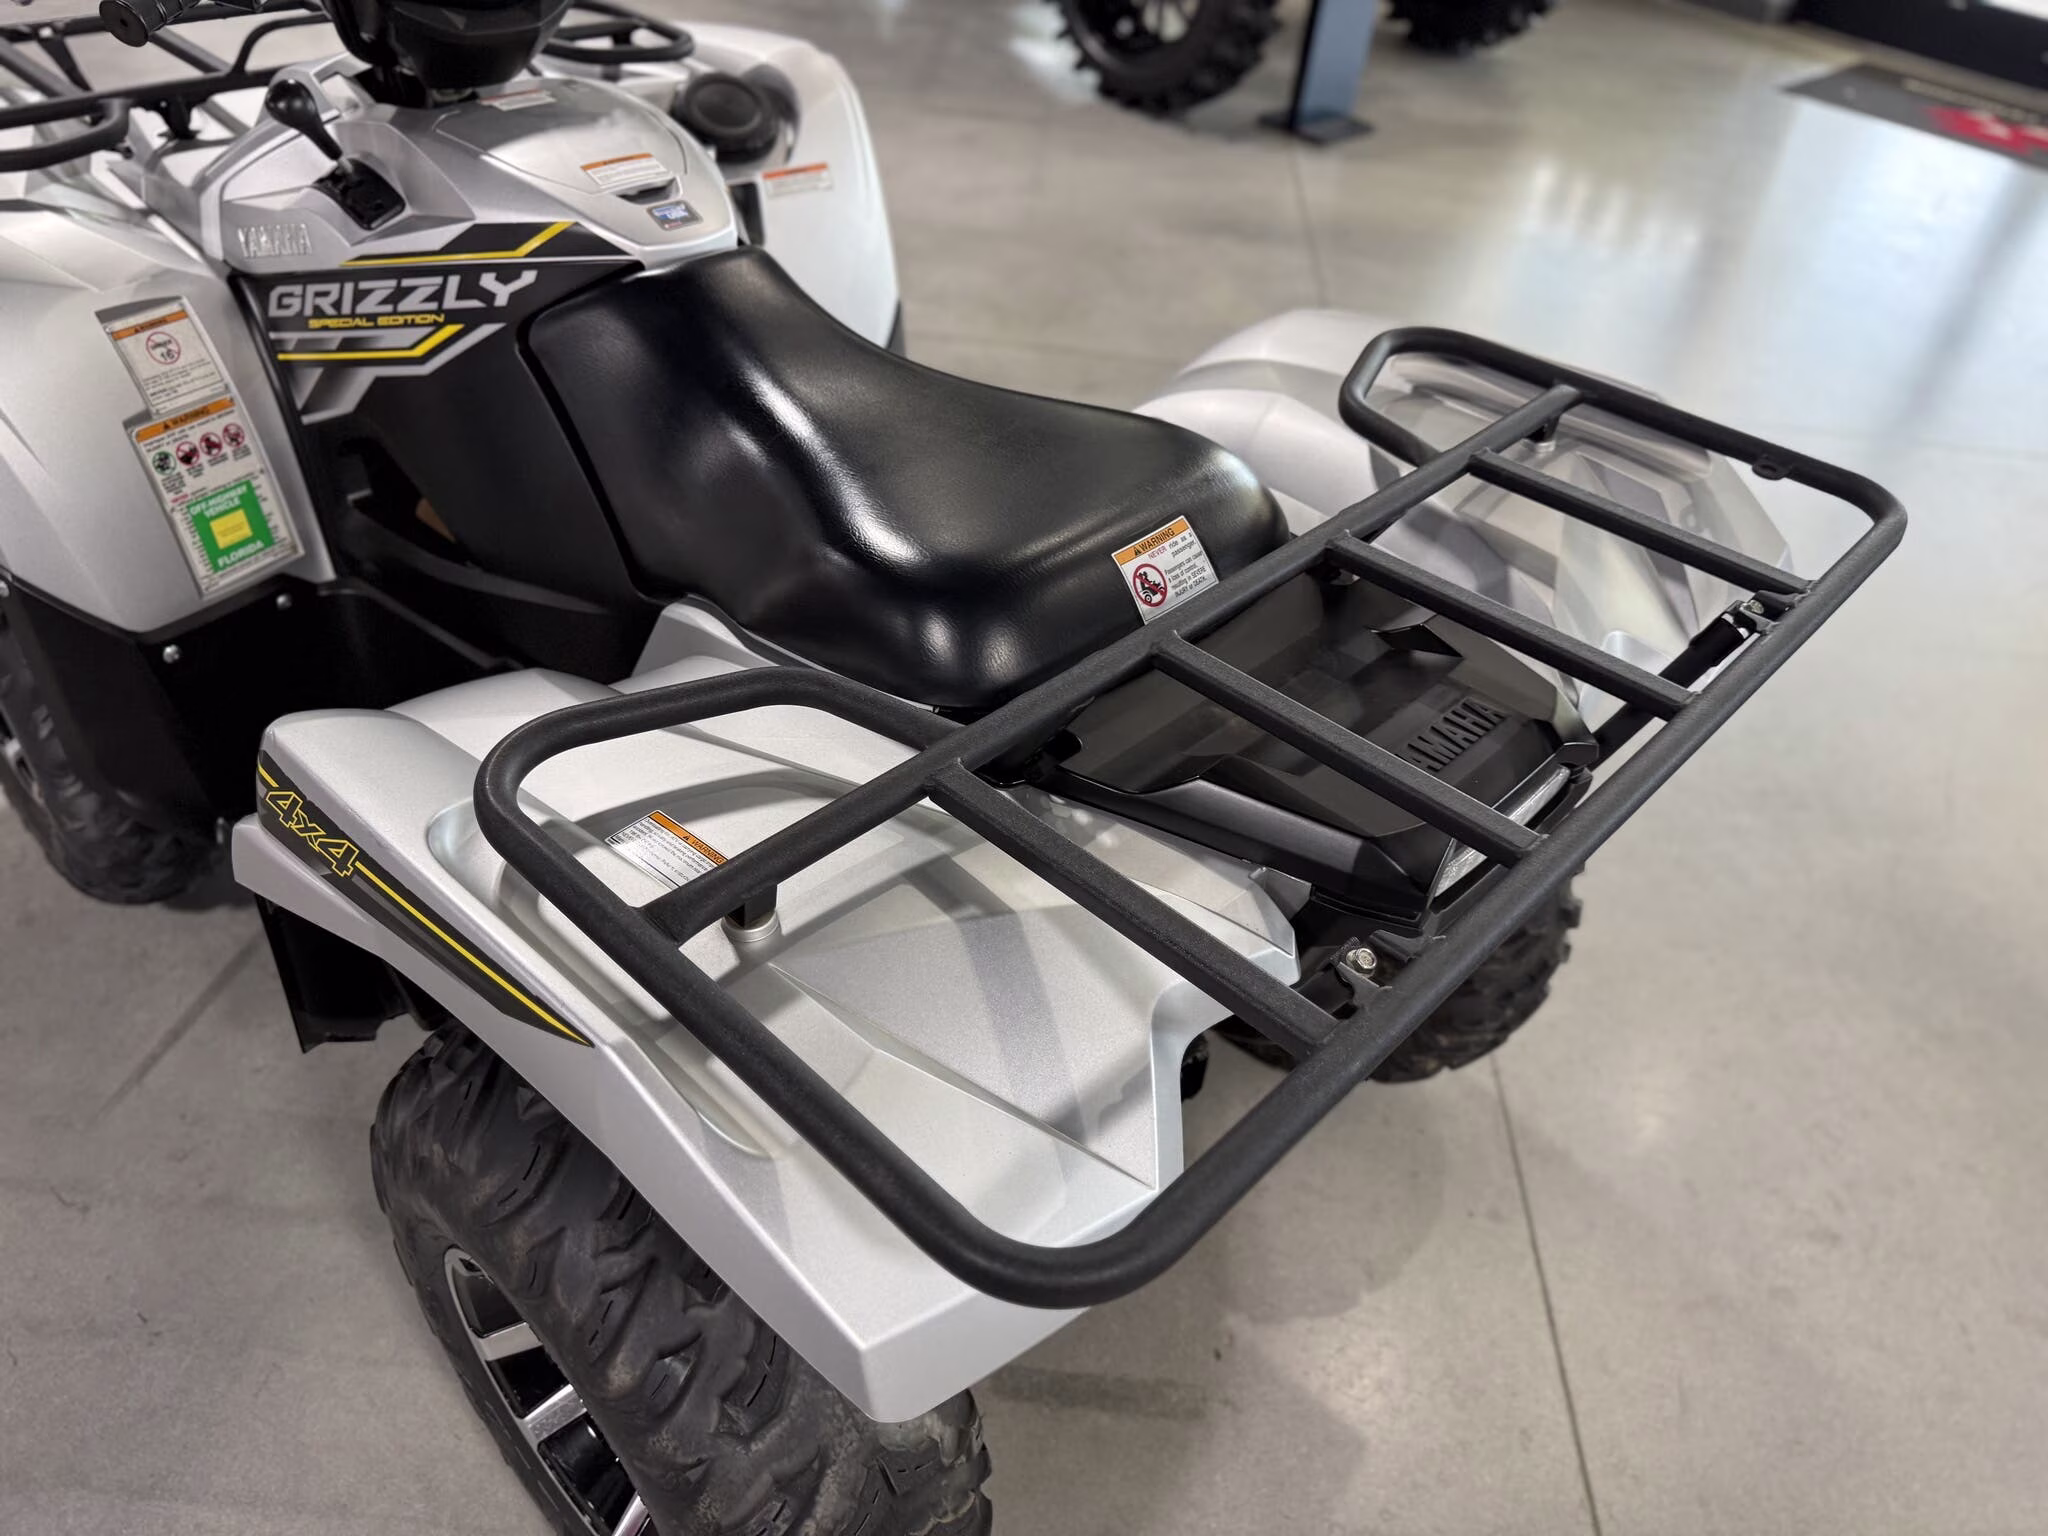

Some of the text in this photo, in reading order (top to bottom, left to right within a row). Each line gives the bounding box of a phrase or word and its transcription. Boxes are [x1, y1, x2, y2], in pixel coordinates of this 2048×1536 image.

[237, 223, 313, 258] YAMAHA
[268, 269, 538, 318] GRIZZLY
[308, 313, 446, 329] SPECIAL EDITION
[161, 348, 175, 361] 16
[203, 496, 241, 518] VEHICLE
[217, 539, 265, 568] FLORIDA
[1140, 527, 1176, 554] WARNING
[1147, 545, 1168, 560] NEVER
[1168, 540, 1179, 550] ride
[1191, 566, 1206, 580] SEVERE
[1394, 698, 1509, 773] AMAHA
[692, 838, 726, 866] WARNING
